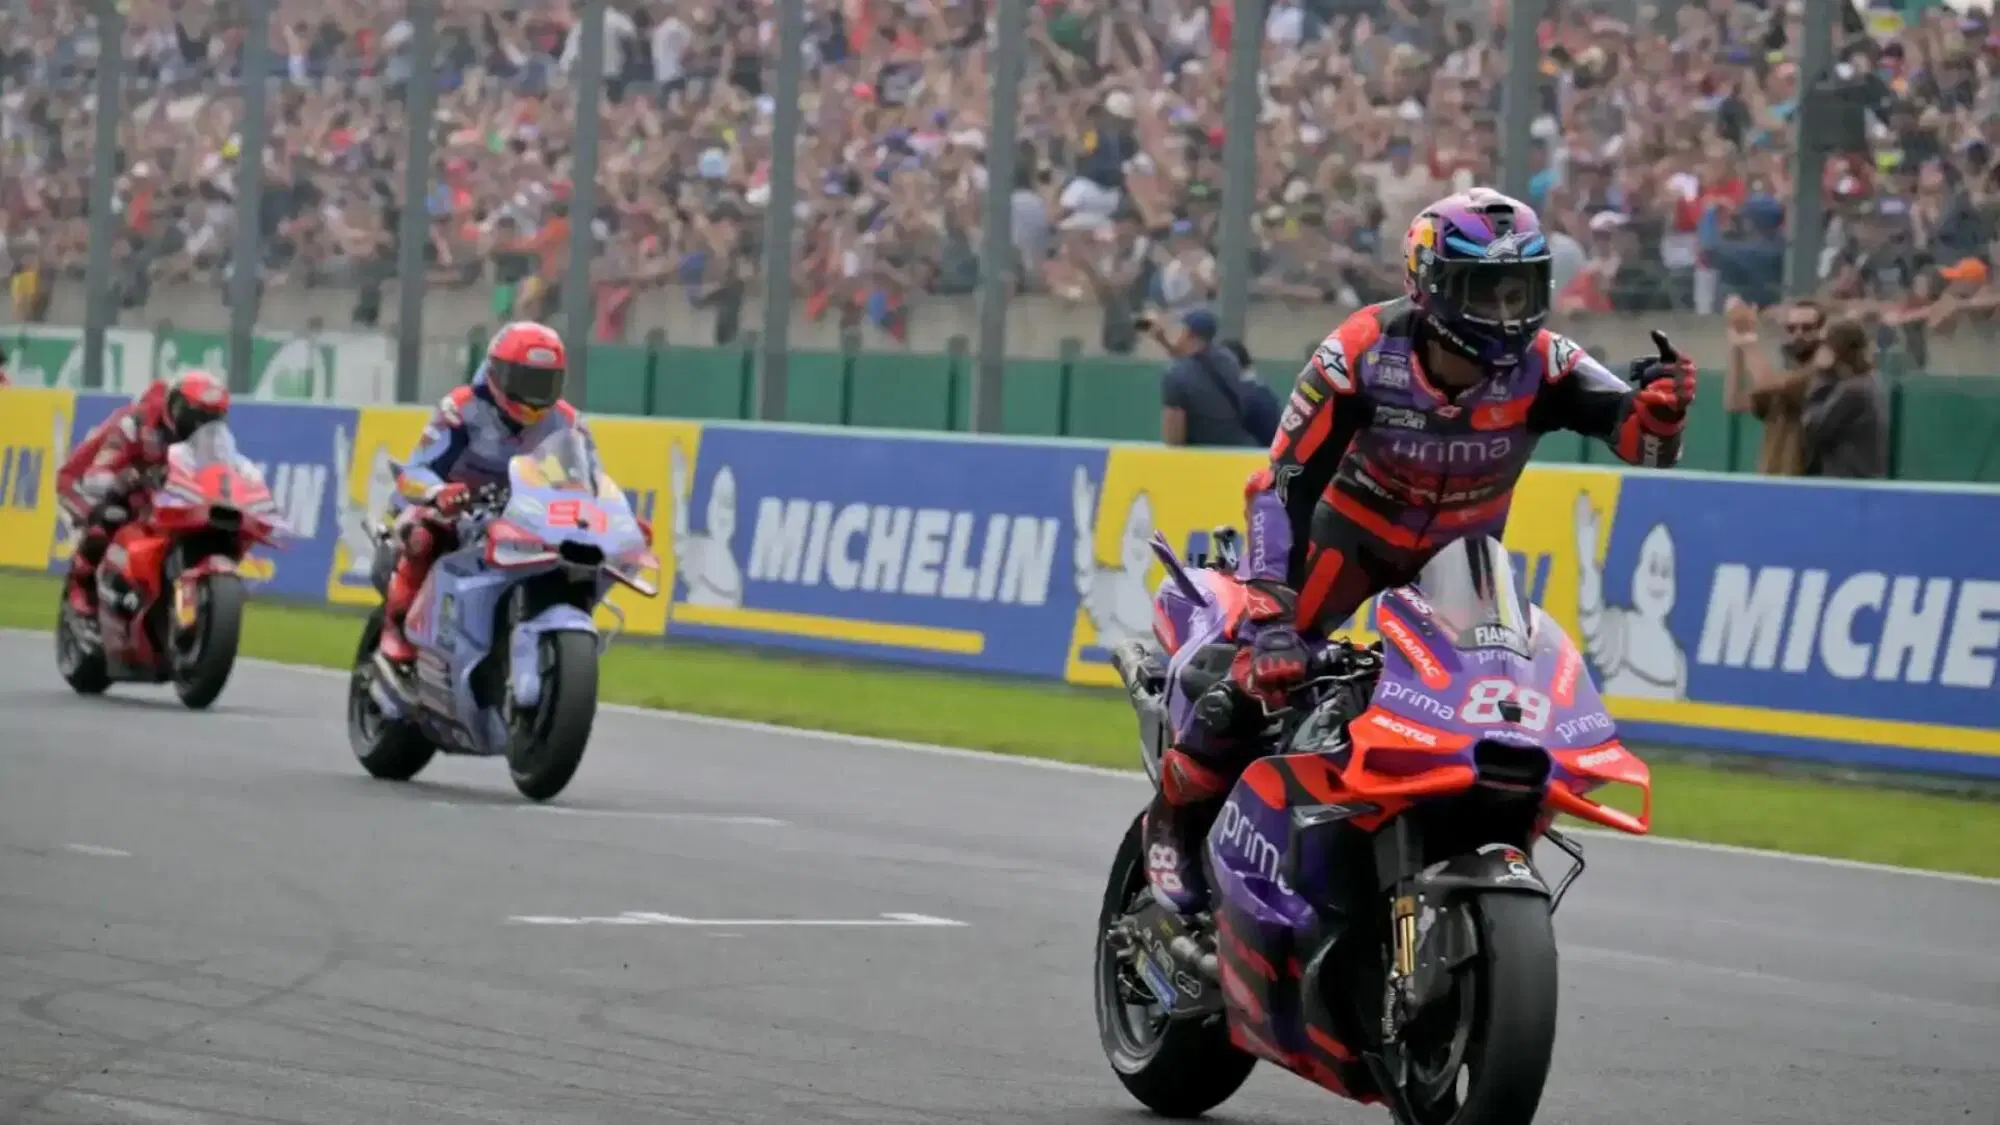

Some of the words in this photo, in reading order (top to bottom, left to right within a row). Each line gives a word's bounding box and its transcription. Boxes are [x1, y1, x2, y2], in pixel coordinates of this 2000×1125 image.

[748, 497, 1060, 606] MICHELIN
[1253, 510, 1267, 573] prima
[1383, 618, 1441, 678] PRAMAC
[1697, 562, 2000, 689] MICHE
[1380, 681, 1455, 721] prima
[1460, 679, 1551, 732] 89
[1555, 711, 1610, 745] prima
